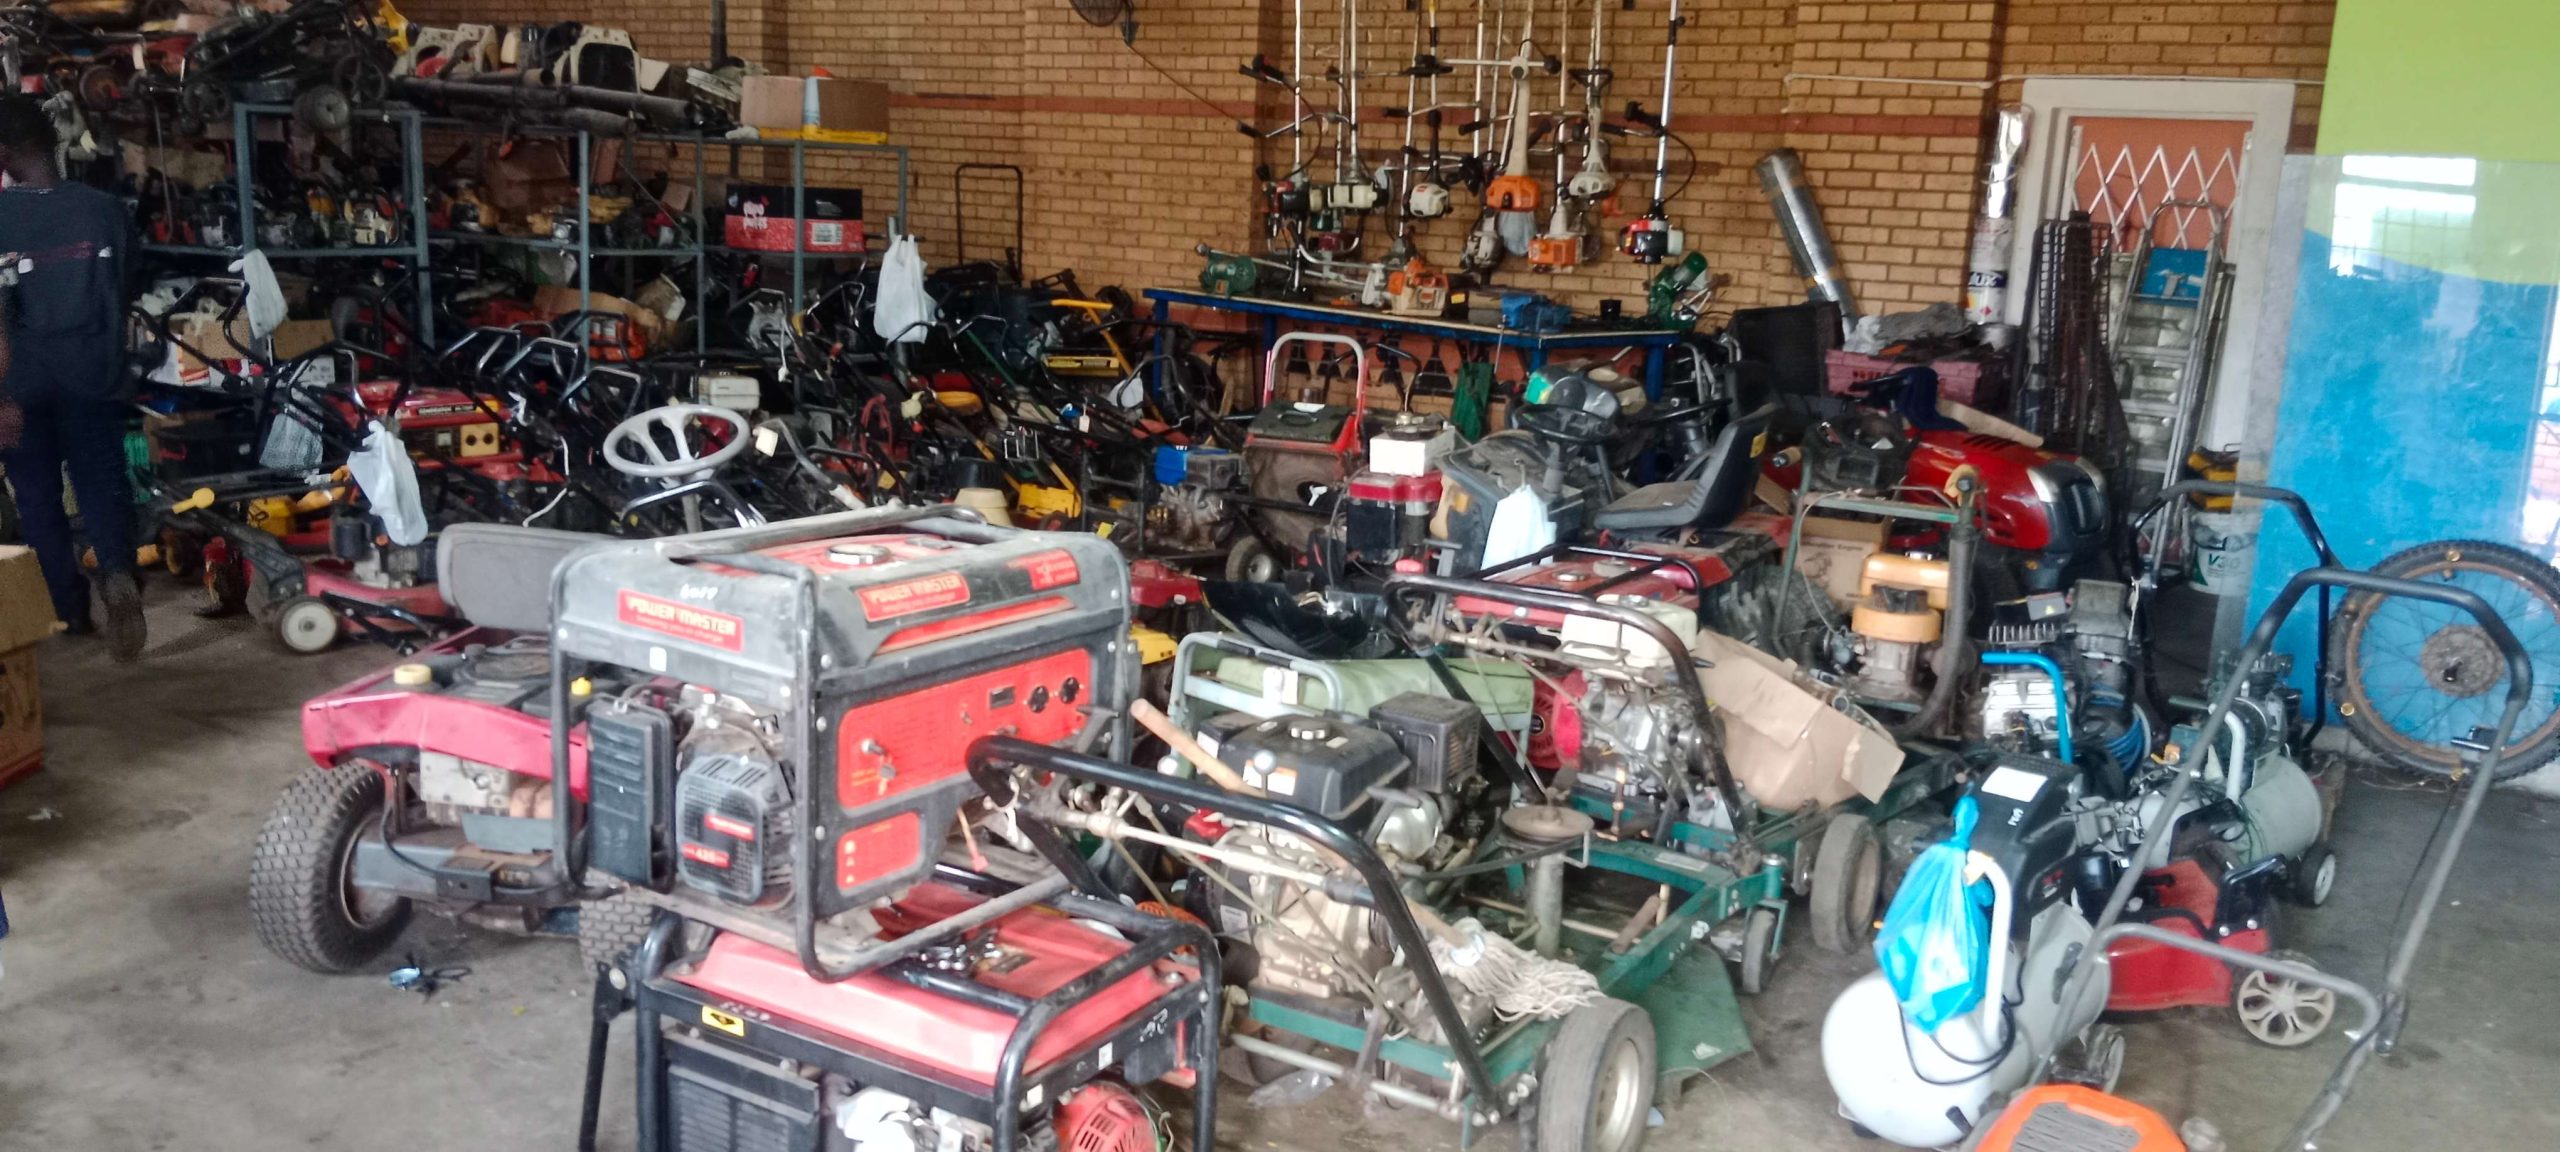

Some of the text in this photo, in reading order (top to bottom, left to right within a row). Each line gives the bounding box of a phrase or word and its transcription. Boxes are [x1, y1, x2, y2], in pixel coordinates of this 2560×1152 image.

[866, 584, 913, 604] POWER
[912, 575, 962, 596] MASTER
[626, 595, 737, 636] POWER MASTER
